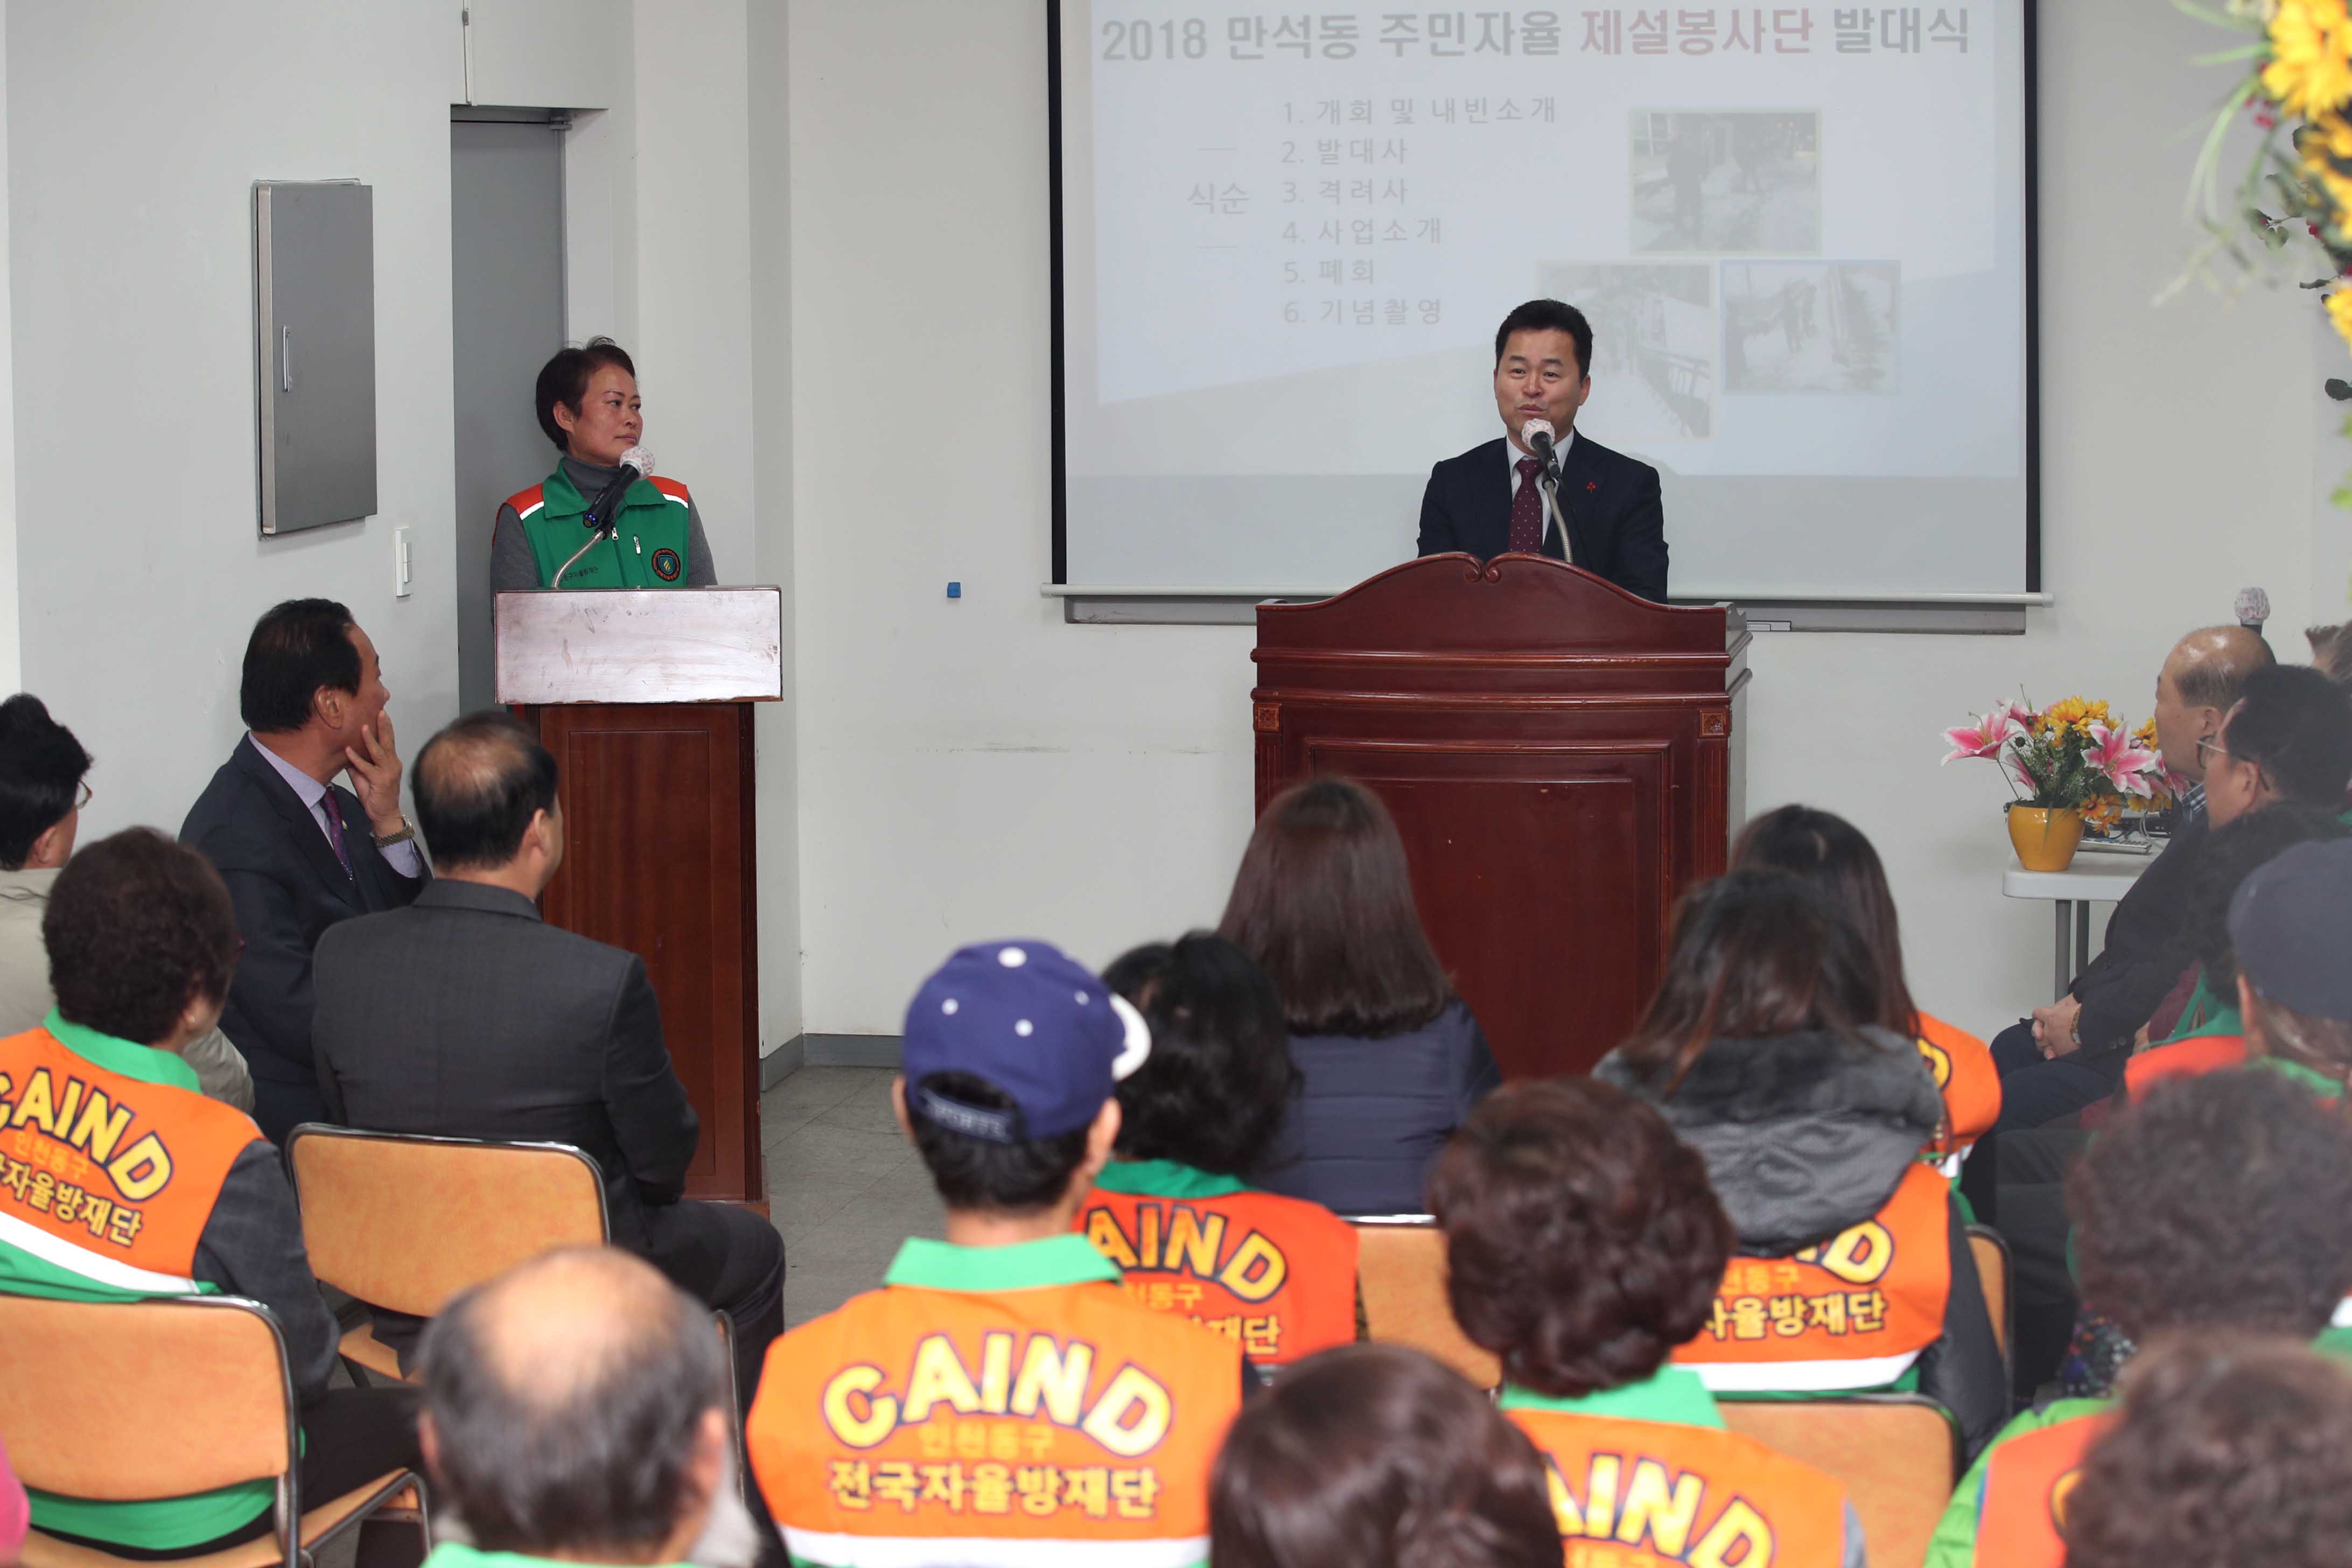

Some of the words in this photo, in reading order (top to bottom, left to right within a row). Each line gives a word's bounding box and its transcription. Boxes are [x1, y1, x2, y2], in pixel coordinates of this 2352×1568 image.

[1102, 18, 1207, 62] 2018
[1227, 15, 1360, 60] 만석동
[1379, 10, 1560, 58] 주민자율
[1580, 8, 1814, 55] 제설봉사단
[1834, 8, 1968, 54] 발대식
[1285, 102, 1303, 124] 1.
[1318, 99, 1373, 125] 개회
[1390, 99, 1416, 124] 및
[1432, 96, 1556, 124] 내빈소개
[1282, 142, 1304, 163] 2.
[1318, 138, 1409, 165] 발대사
[1188, 183, 1250, 214] 식순
[1283, 182, 1304, 203] 3.
[1319, 179, 1409, 205] 격려사
[1282, 221, 1305, 243] 4.
[1319, 218, 1441, 246] 사업소개
[1285, 262, 1305, 283] 5.
[1319, 258, 1375, 285] 폐회
[1285, 302, 1305, 323] 6.
[1320, 298, 1443, 324] 기념촬영
[0, 1151, 143, 1248] 자율방재단
[1086, 1202, 1287, 1303] AIND
[823, 1332, 1173, 1458] CAIND
[829, 1459, 1160, 1518] 전국자율방재단
